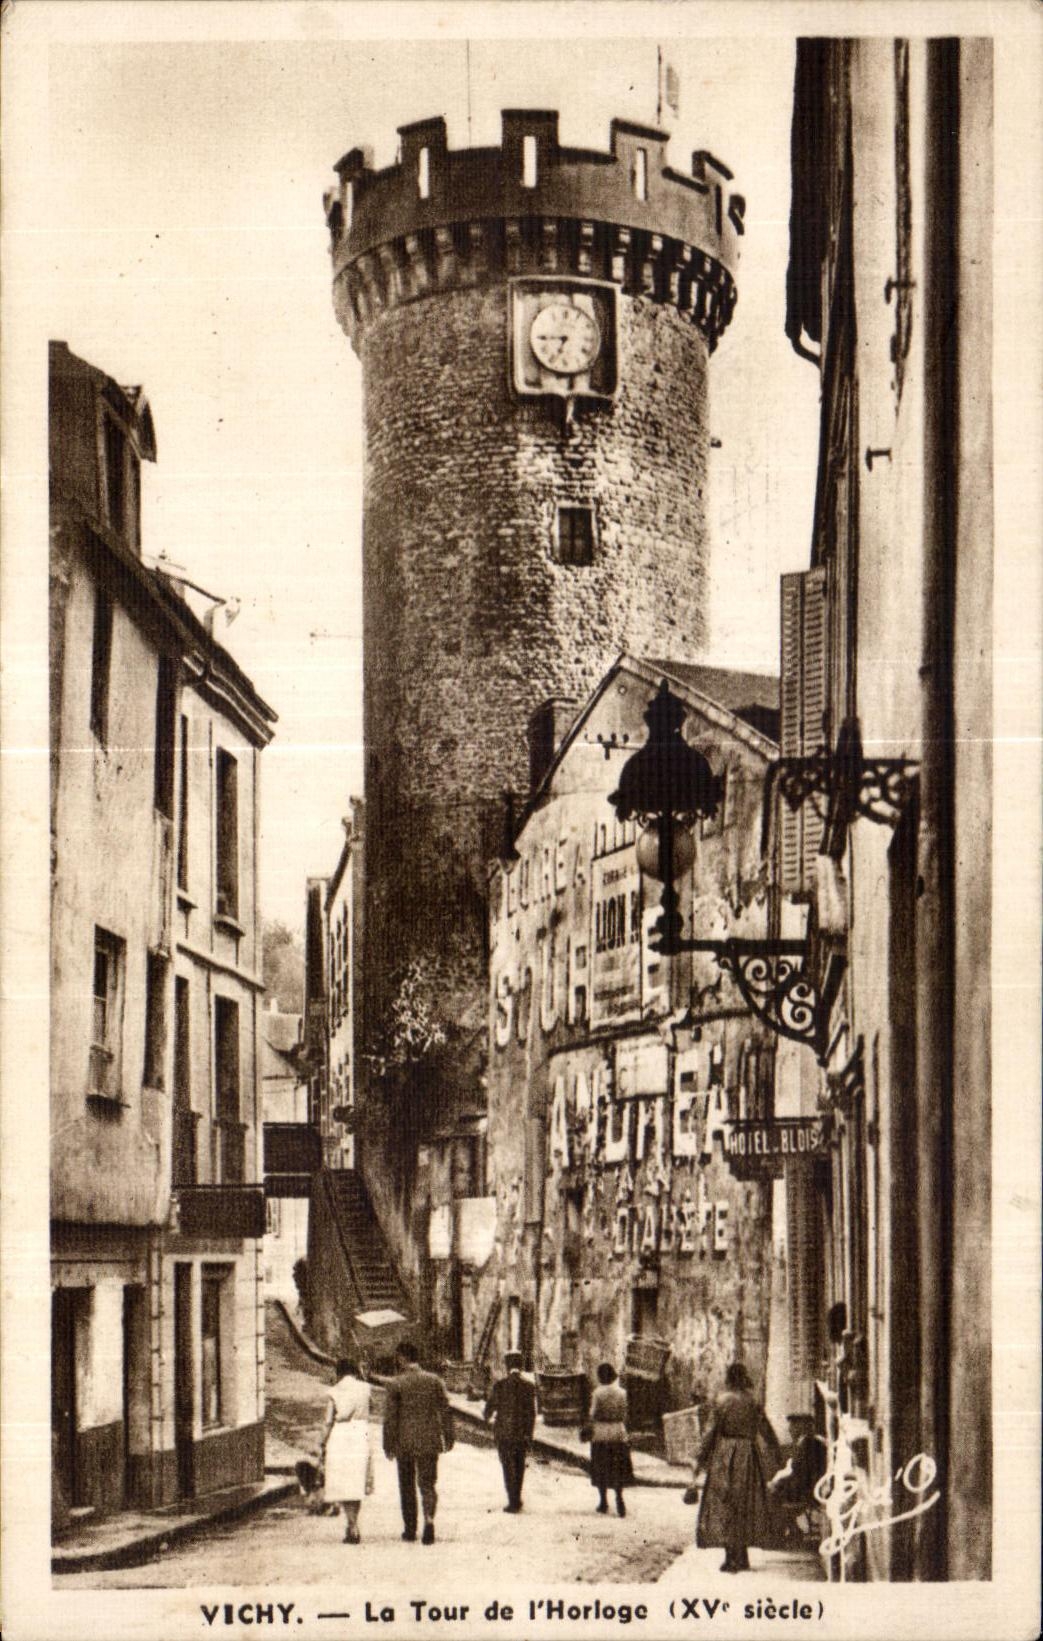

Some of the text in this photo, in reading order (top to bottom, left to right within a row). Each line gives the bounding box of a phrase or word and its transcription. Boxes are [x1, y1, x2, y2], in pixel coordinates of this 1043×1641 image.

[494, 904, 672, 1048] SOURE
[729, 1128, 818, 1156] HOTEL BLOIS
